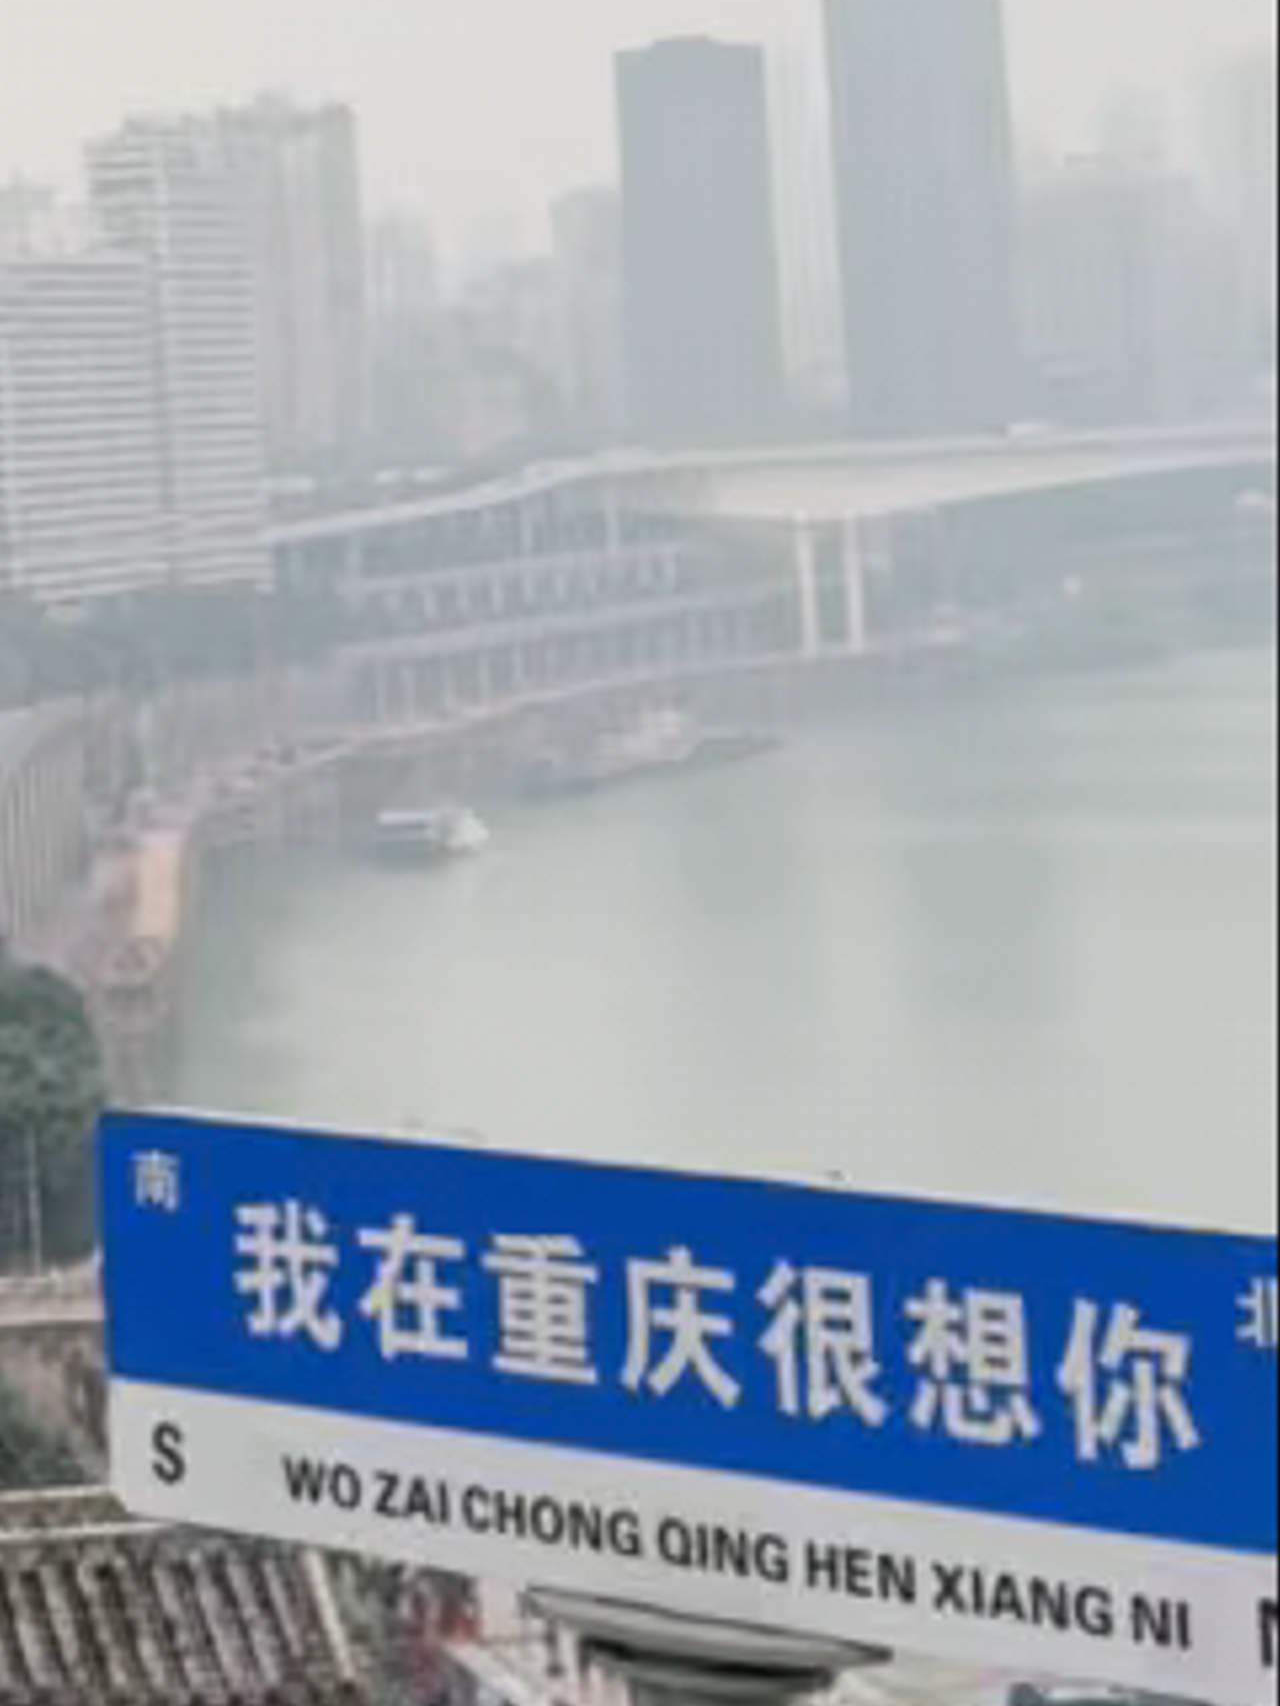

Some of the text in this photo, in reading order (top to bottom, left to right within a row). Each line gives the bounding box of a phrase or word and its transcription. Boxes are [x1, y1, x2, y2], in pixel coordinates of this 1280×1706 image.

[130, 1149, 181, 1211] 南
[233, 1199, 1200, 1471] 我在重庆很想你
[150, 1421, 187, 1486] S
[282, 1457, 363, 1510] WO
[373, 1471, 451, 1525] ZAI
[460, 1484, 643, 1558] CHONG
[656, 1516, 790, 1584] QING
[804, 1541, 917, 1605] HEN
[931, 1562, 1115, 1638] XIANG
[1130, 1594, 1192, 1651] NI
